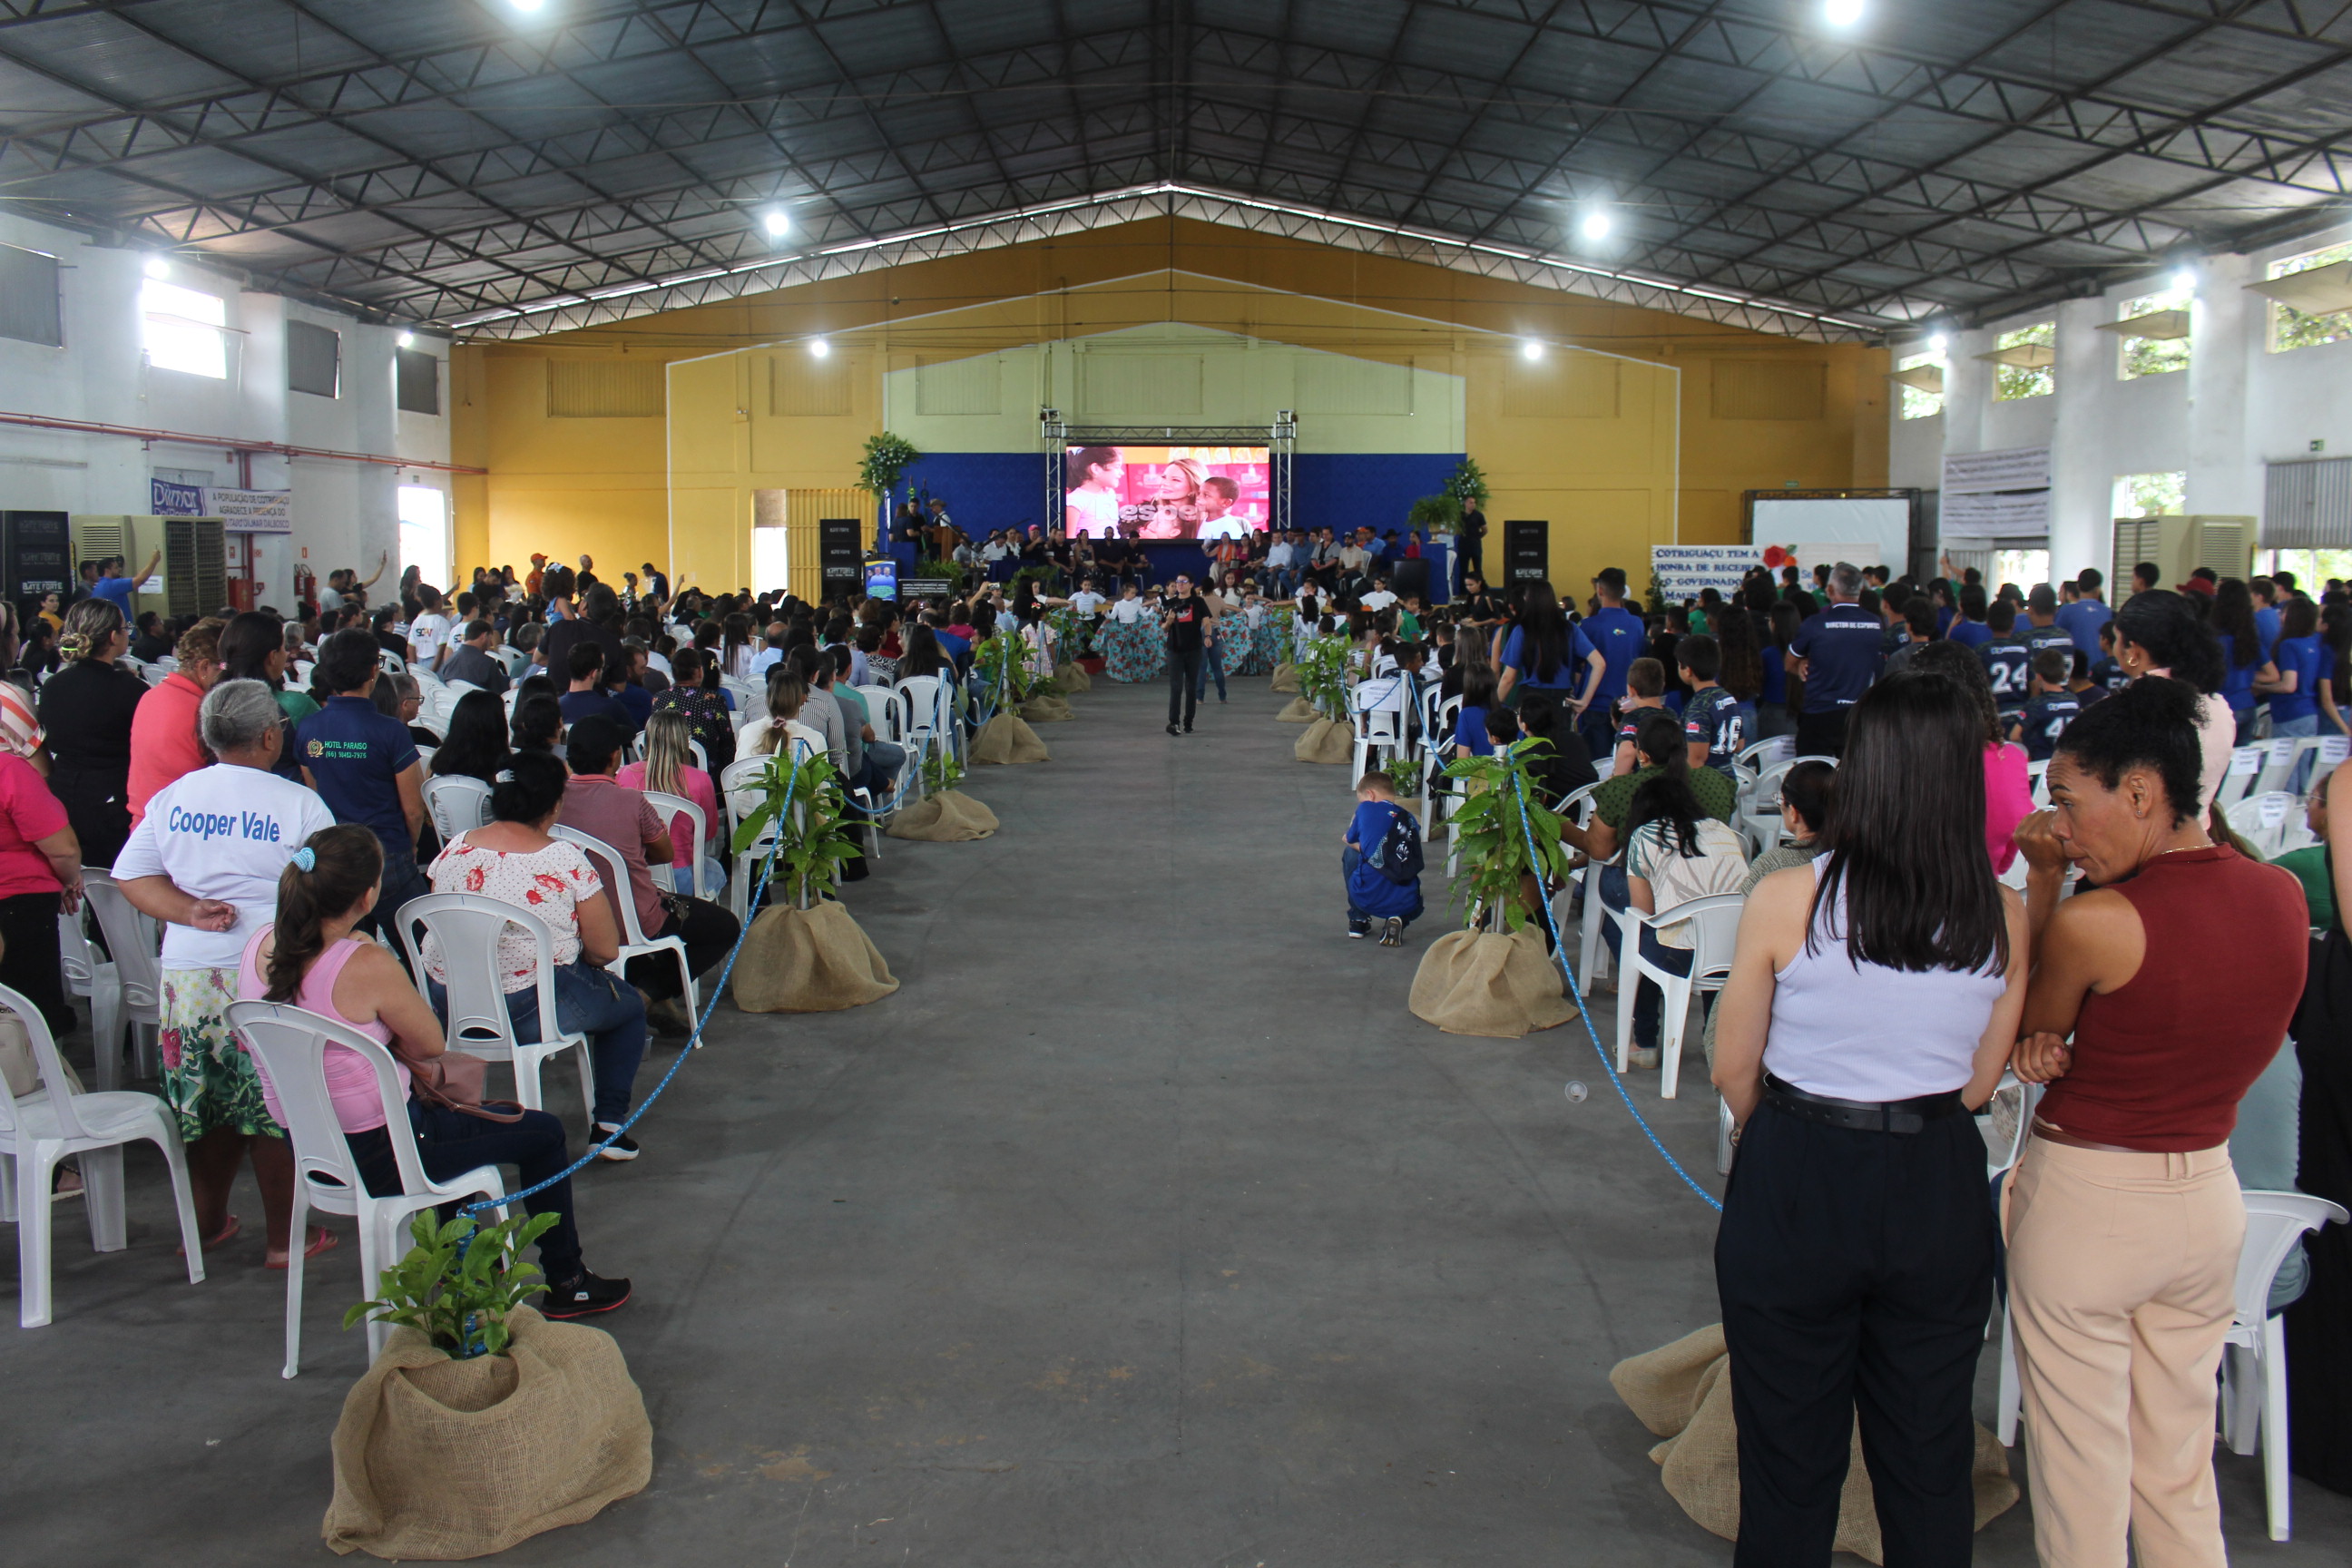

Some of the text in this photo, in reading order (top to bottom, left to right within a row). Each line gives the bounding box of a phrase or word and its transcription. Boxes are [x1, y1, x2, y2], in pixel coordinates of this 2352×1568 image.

[153, 483, 197, 508] Dilmar
[212, 493, 217, 501] A
[217, 493, 248, 505] POPULAÇÃO
[249, 495, 257, 504] DE
[219, 505, 248, 515] AGRADECE
[263, 520, 289, 528] DALBOSCO
[1656, 549, 1759, 560] COTRIGUAÇU TEM A
[1656, 564, 1751, 572] HONRA DE RECEBE
[1664, 577, 1744, 586] O GOVERNADO
[22, 582, 41, 591] BATE
[42, 582, 64, 590] FORTE
[1990, 662, 2028, 694] 24
[324, 740, 342, 749] HOTEL
[325, 750, 337, 759] (66)
[169, 805, 280, 843] Cooper Vale
